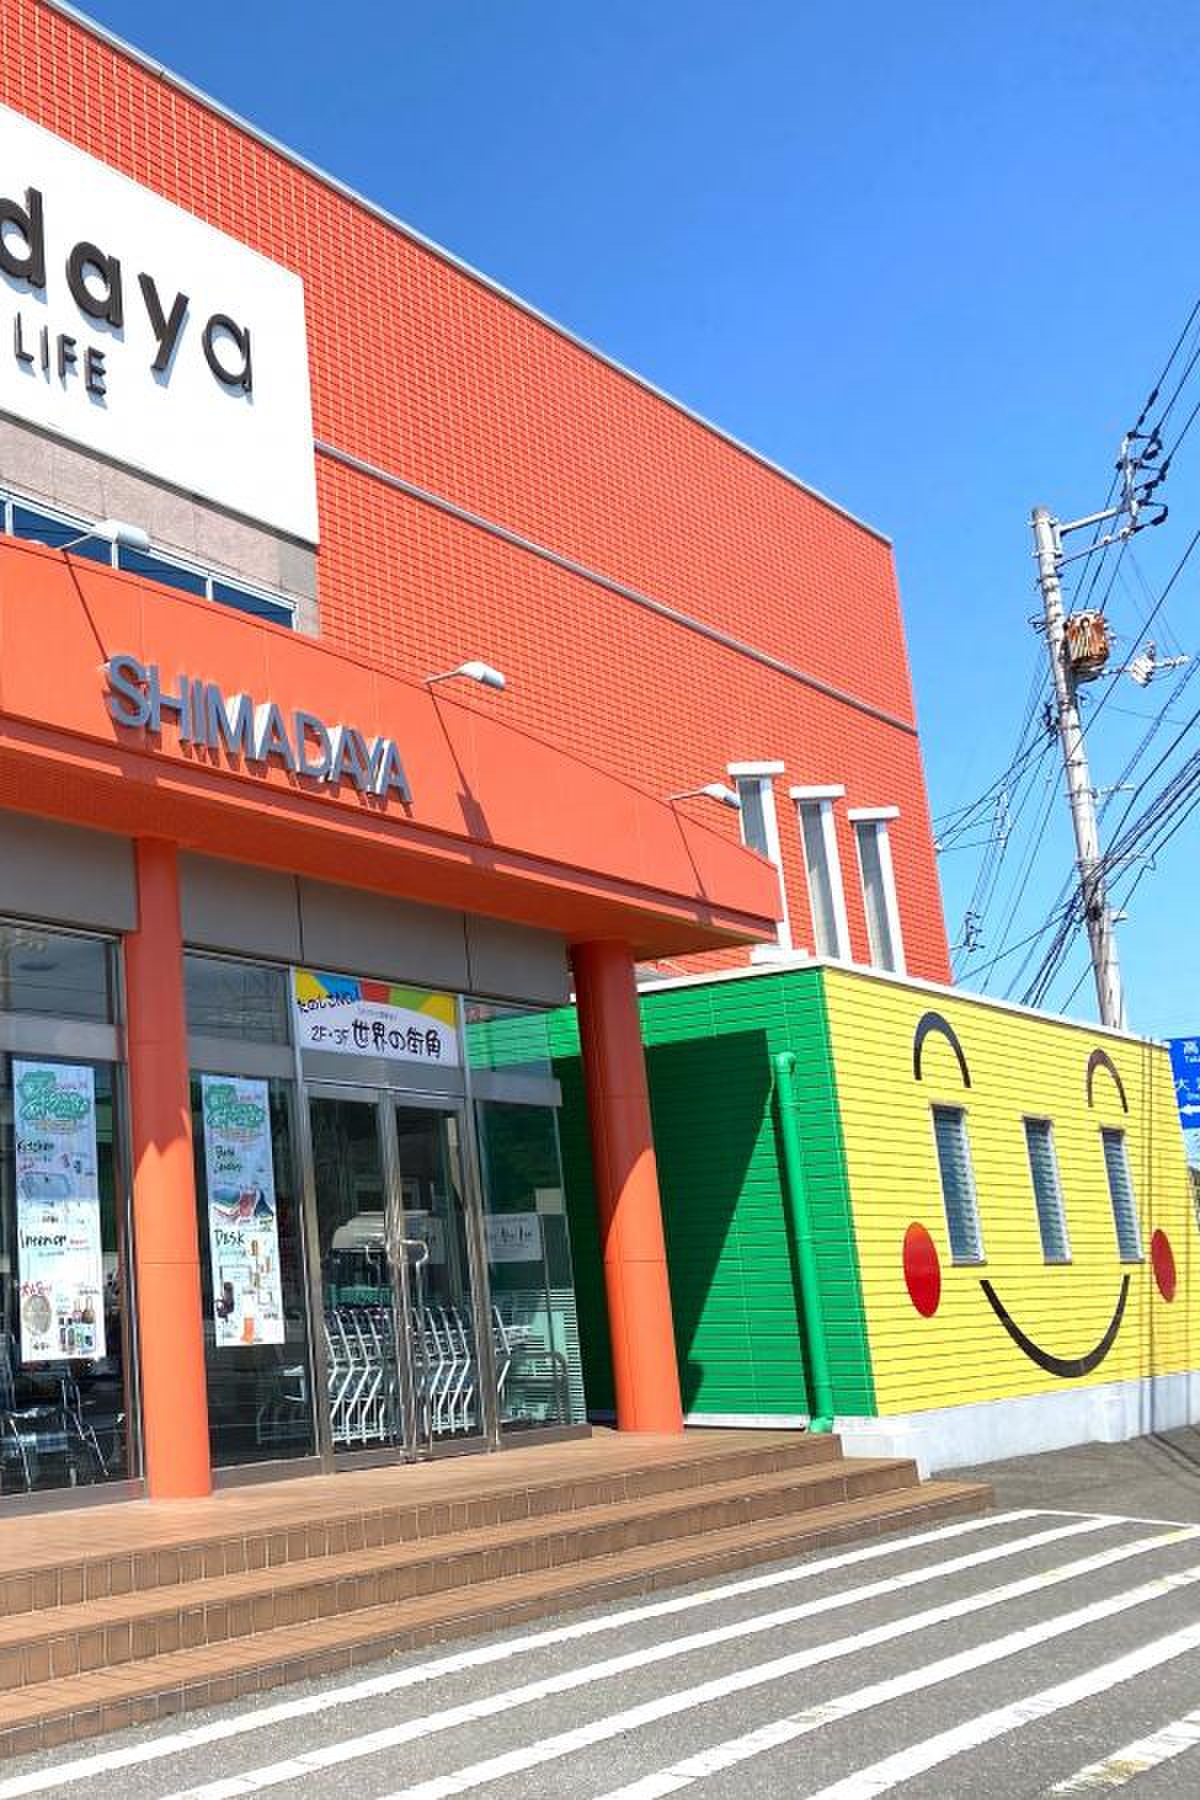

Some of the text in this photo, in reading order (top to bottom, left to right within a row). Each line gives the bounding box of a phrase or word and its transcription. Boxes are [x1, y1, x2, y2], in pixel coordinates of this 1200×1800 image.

[14, 312, 107, 395] LIFE
[103, 654, 414, 806] SHIMADAYA
[351, 1018, 442, 1059] 世界の街角
